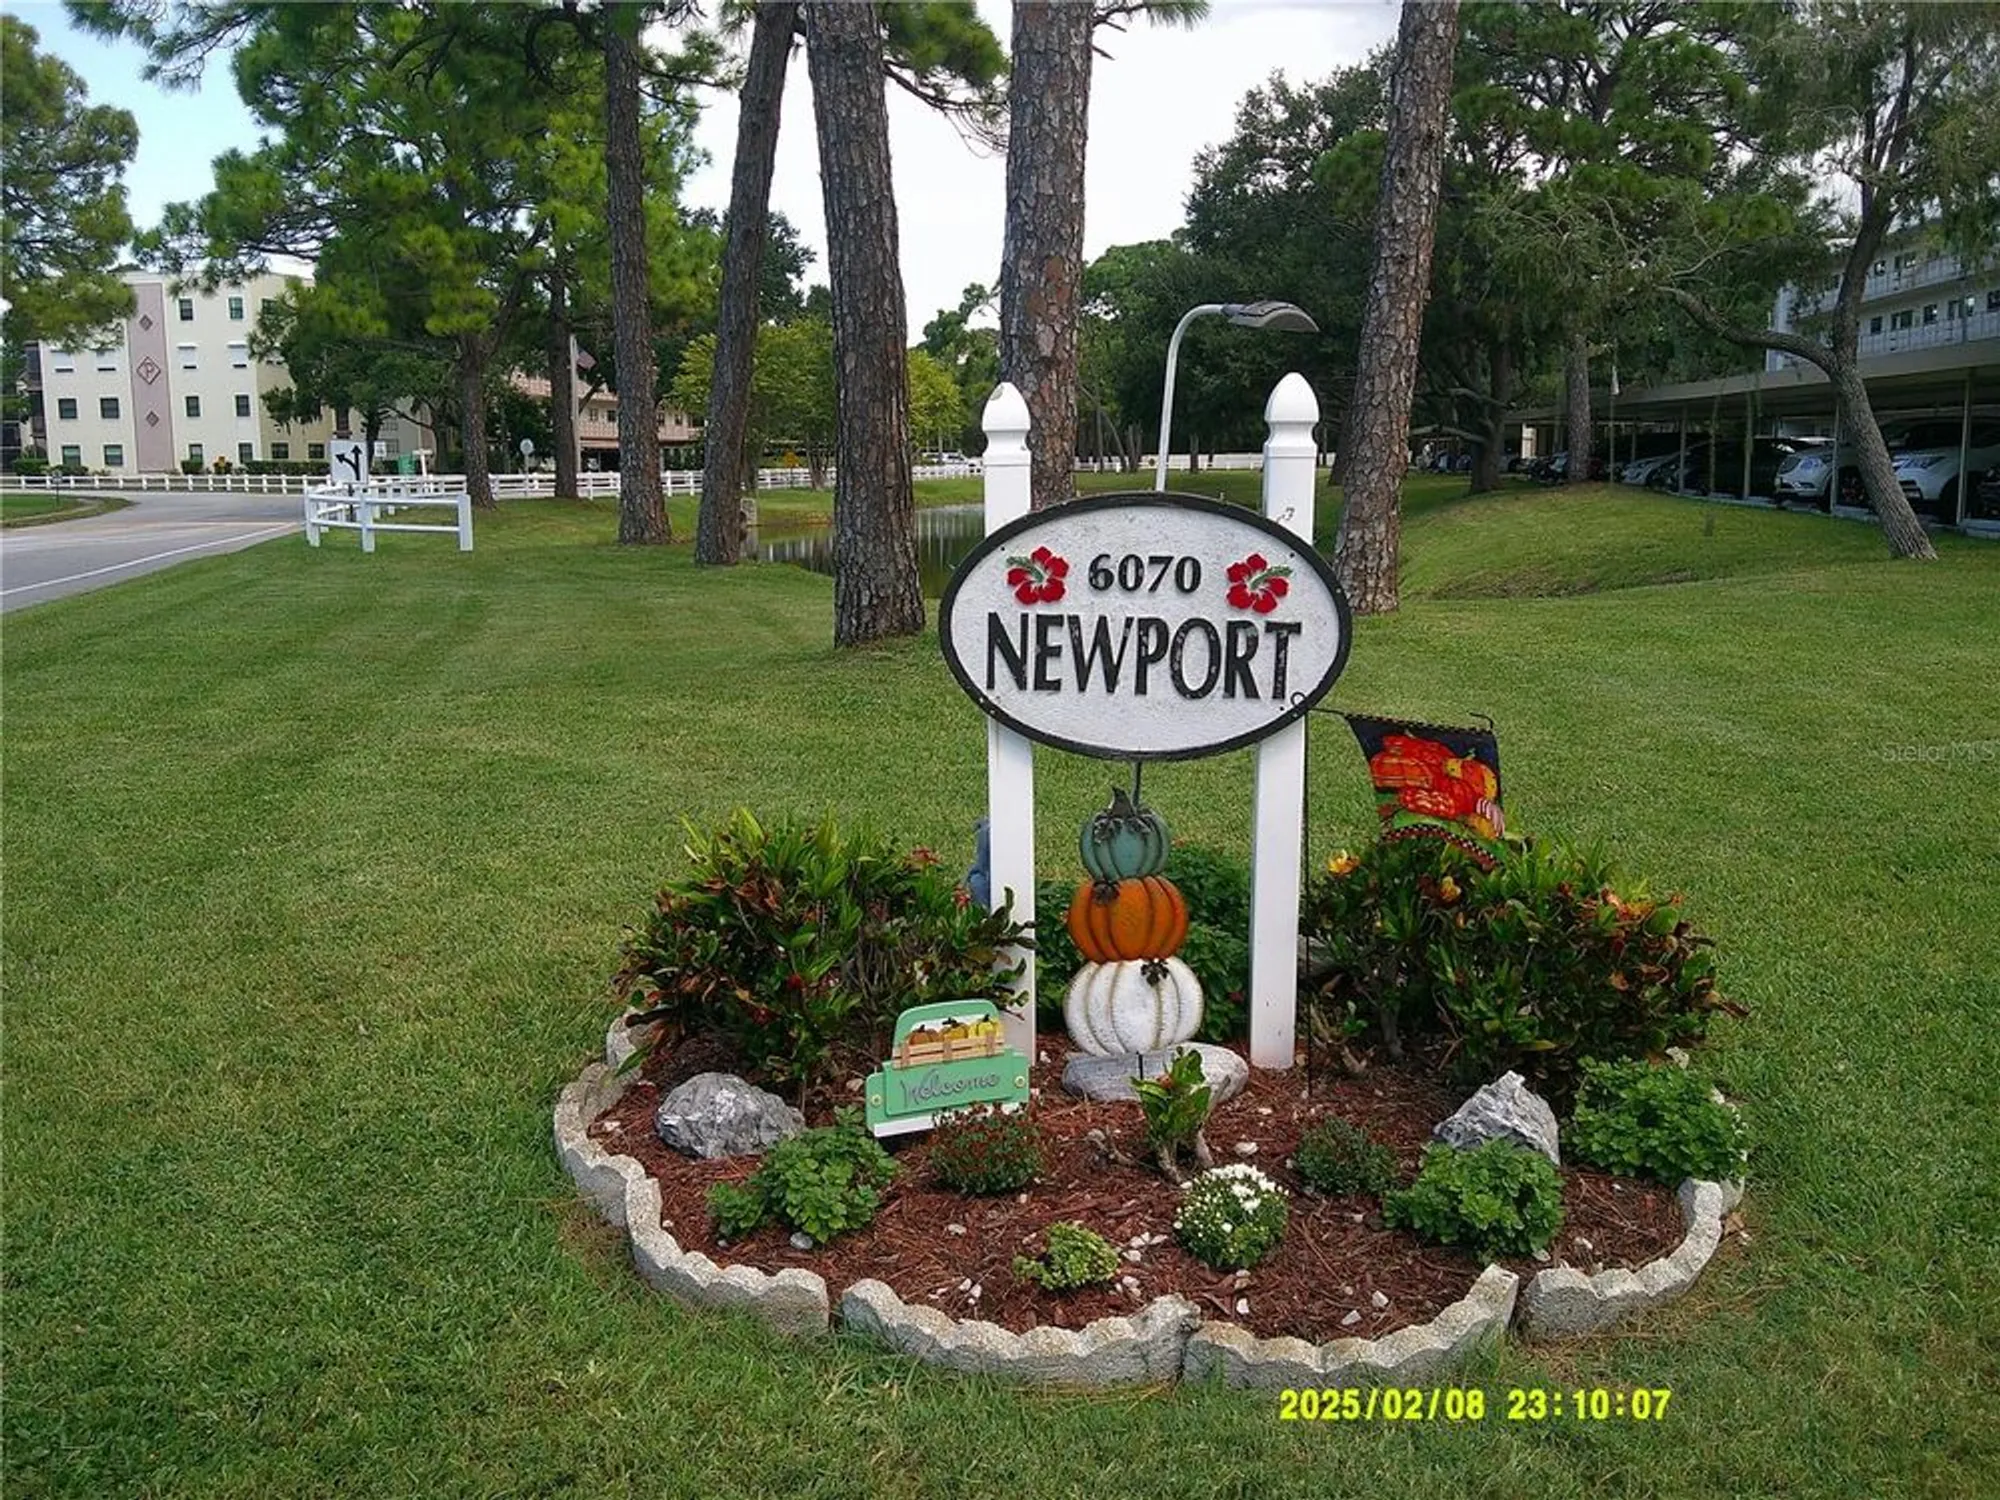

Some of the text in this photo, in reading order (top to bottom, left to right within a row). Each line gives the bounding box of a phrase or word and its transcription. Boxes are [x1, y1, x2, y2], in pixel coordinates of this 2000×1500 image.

[1088, 553, 1202, 594] 6070
[986, 611, 1302, 701] NEWPORT
[899, 1067, 1000, 1109] Welcome
